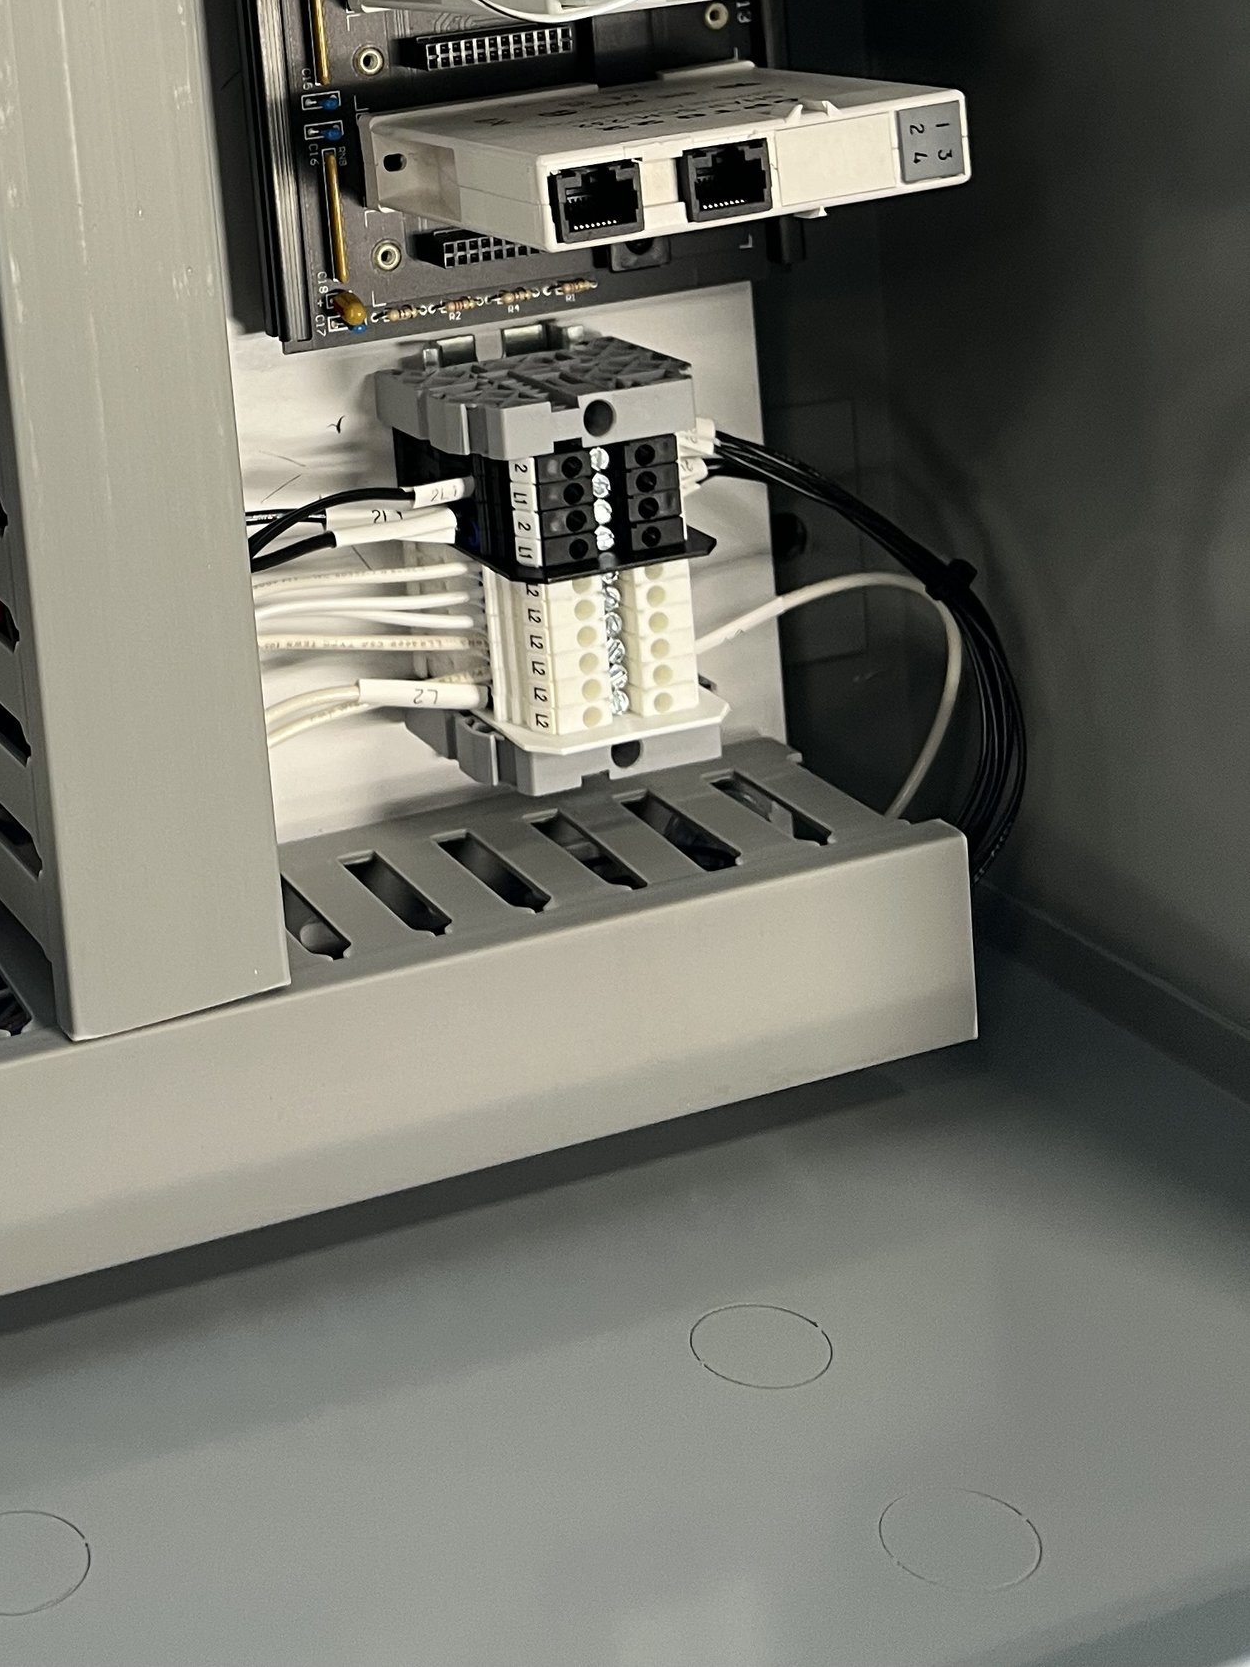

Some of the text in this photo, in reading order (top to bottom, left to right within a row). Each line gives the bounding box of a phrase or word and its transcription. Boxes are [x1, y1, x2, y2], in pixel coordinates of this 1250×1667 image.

[301, 67, 312, 90] C15
[910, 124, 927, 163] 2 4
[308, 144, 319, 166] C16
[938, 150, 952, 160] 3
[317, 271, 329, 294] C18
[565, 294, 576, 302] R1
[449, 311, 462, 321] R2
[507, 304, 520, 313] R4
[315, 314, 326, 336] C17
[514, 463, 529, 474] 2
[513, 491, 528, 506] L1
[518, 521, 532, 533] 2
[516, 545, 533, 560] L1
[526, 585, 539, 599] L2
[528, 609, 542, 625] L2
[530, 635, 544, 650] L2
[531, 661, 546, 676] L2
[413, 688, 438, 704] L2
[533, 687, 548, 702] L2
[536, 713, 550, 729] L2
